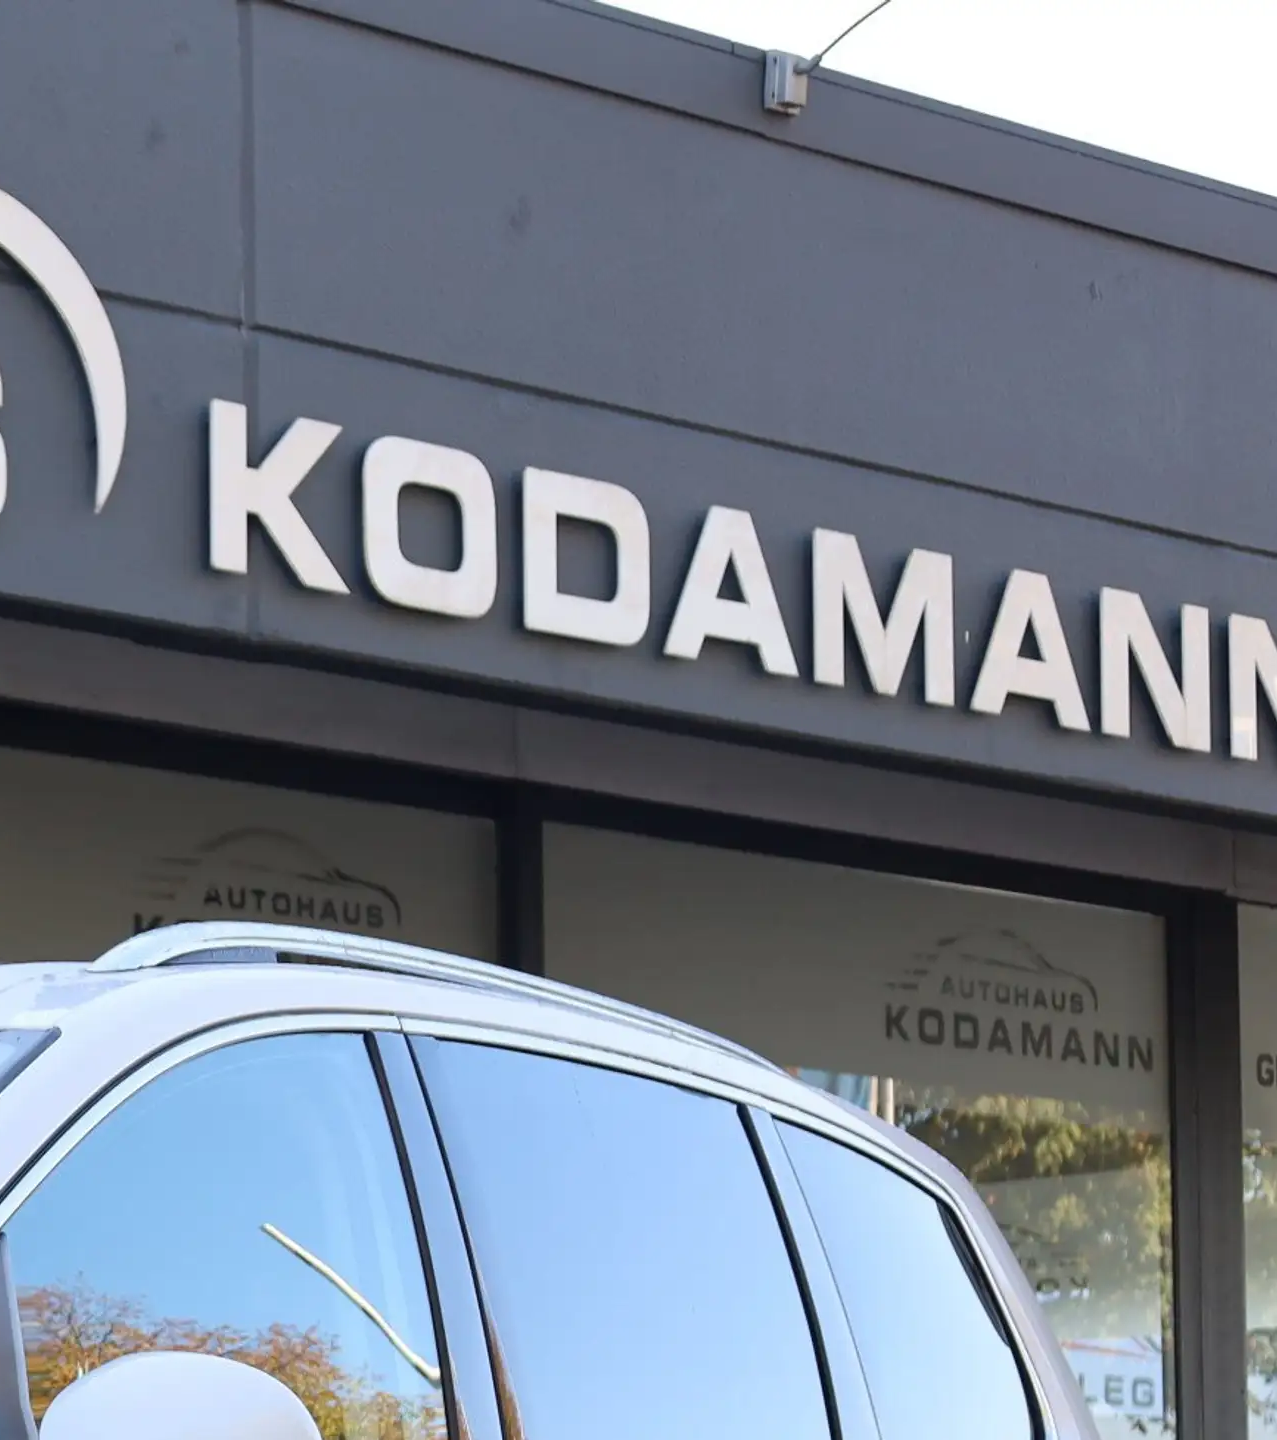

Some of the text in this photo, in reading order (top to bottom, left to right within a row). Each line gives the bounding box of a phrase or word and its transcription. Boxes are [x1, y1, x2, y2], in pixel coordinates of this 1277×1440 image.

[202, 885, 384, 929] AUTOHAUS
[940, 975, 1085, 1015] AUTOHAUS
[884, 1003, 1155, 1073] KODAMANN
